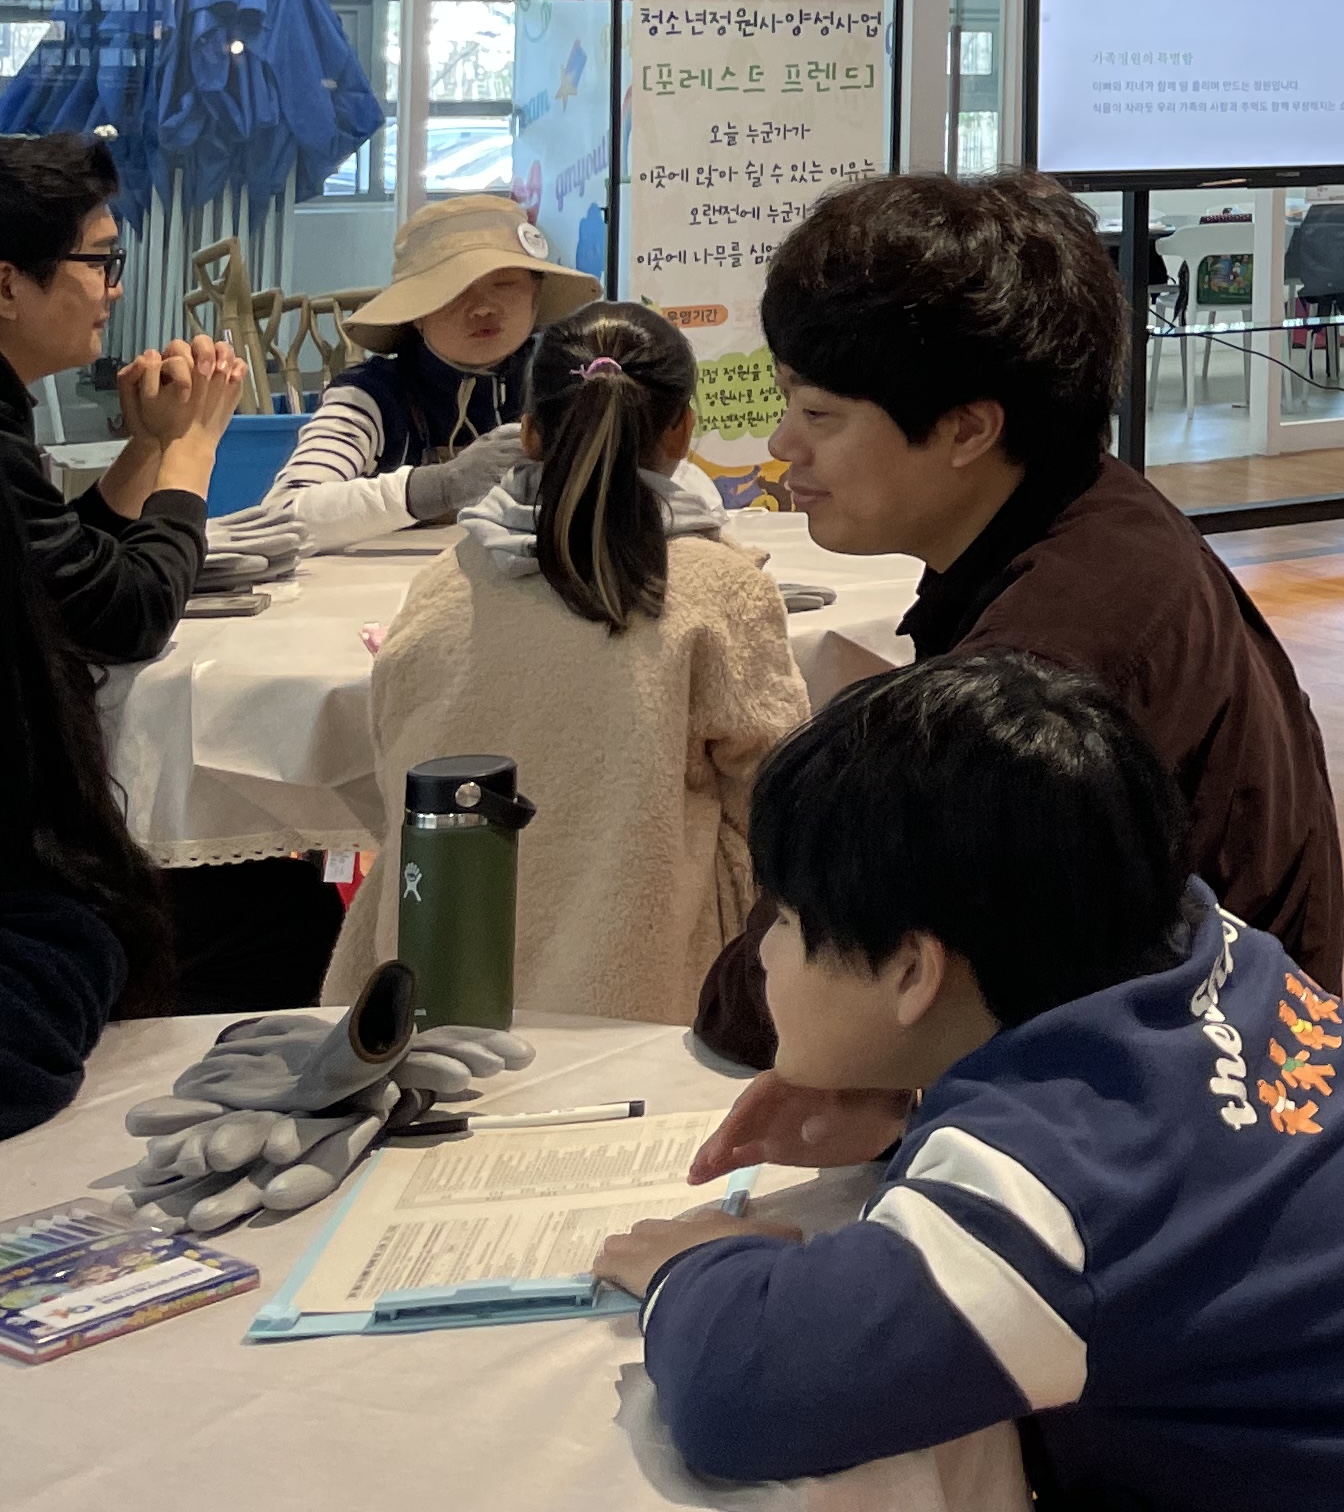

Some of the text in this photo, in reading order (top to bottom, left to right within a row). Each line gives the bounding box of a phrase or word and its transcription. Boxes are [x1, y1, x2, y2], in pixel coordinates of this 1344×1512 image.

[640, 7, 882, 38] 청소년정원사양성사업
[643, 61, 874, 96] [포레스트 프렌드]
[710, 121, 811, 145] 오늘 누군가가
[640, 165, 690, 189] 이곳에
[697, 165, 738, 189] 앉아
[745, 159, 764, 185] 쉴
[770, 163, 785, 183] 수
[790, 160, 824, 183] 있는
[689, 202, 761, 226] 오랜전에
[637, 248, 687, 272] 이곳에
[694, 242, 743, 268] 나무를
[723, 363, 761, 382] 정원을
[705, 389, 754, 407] 정원사로
